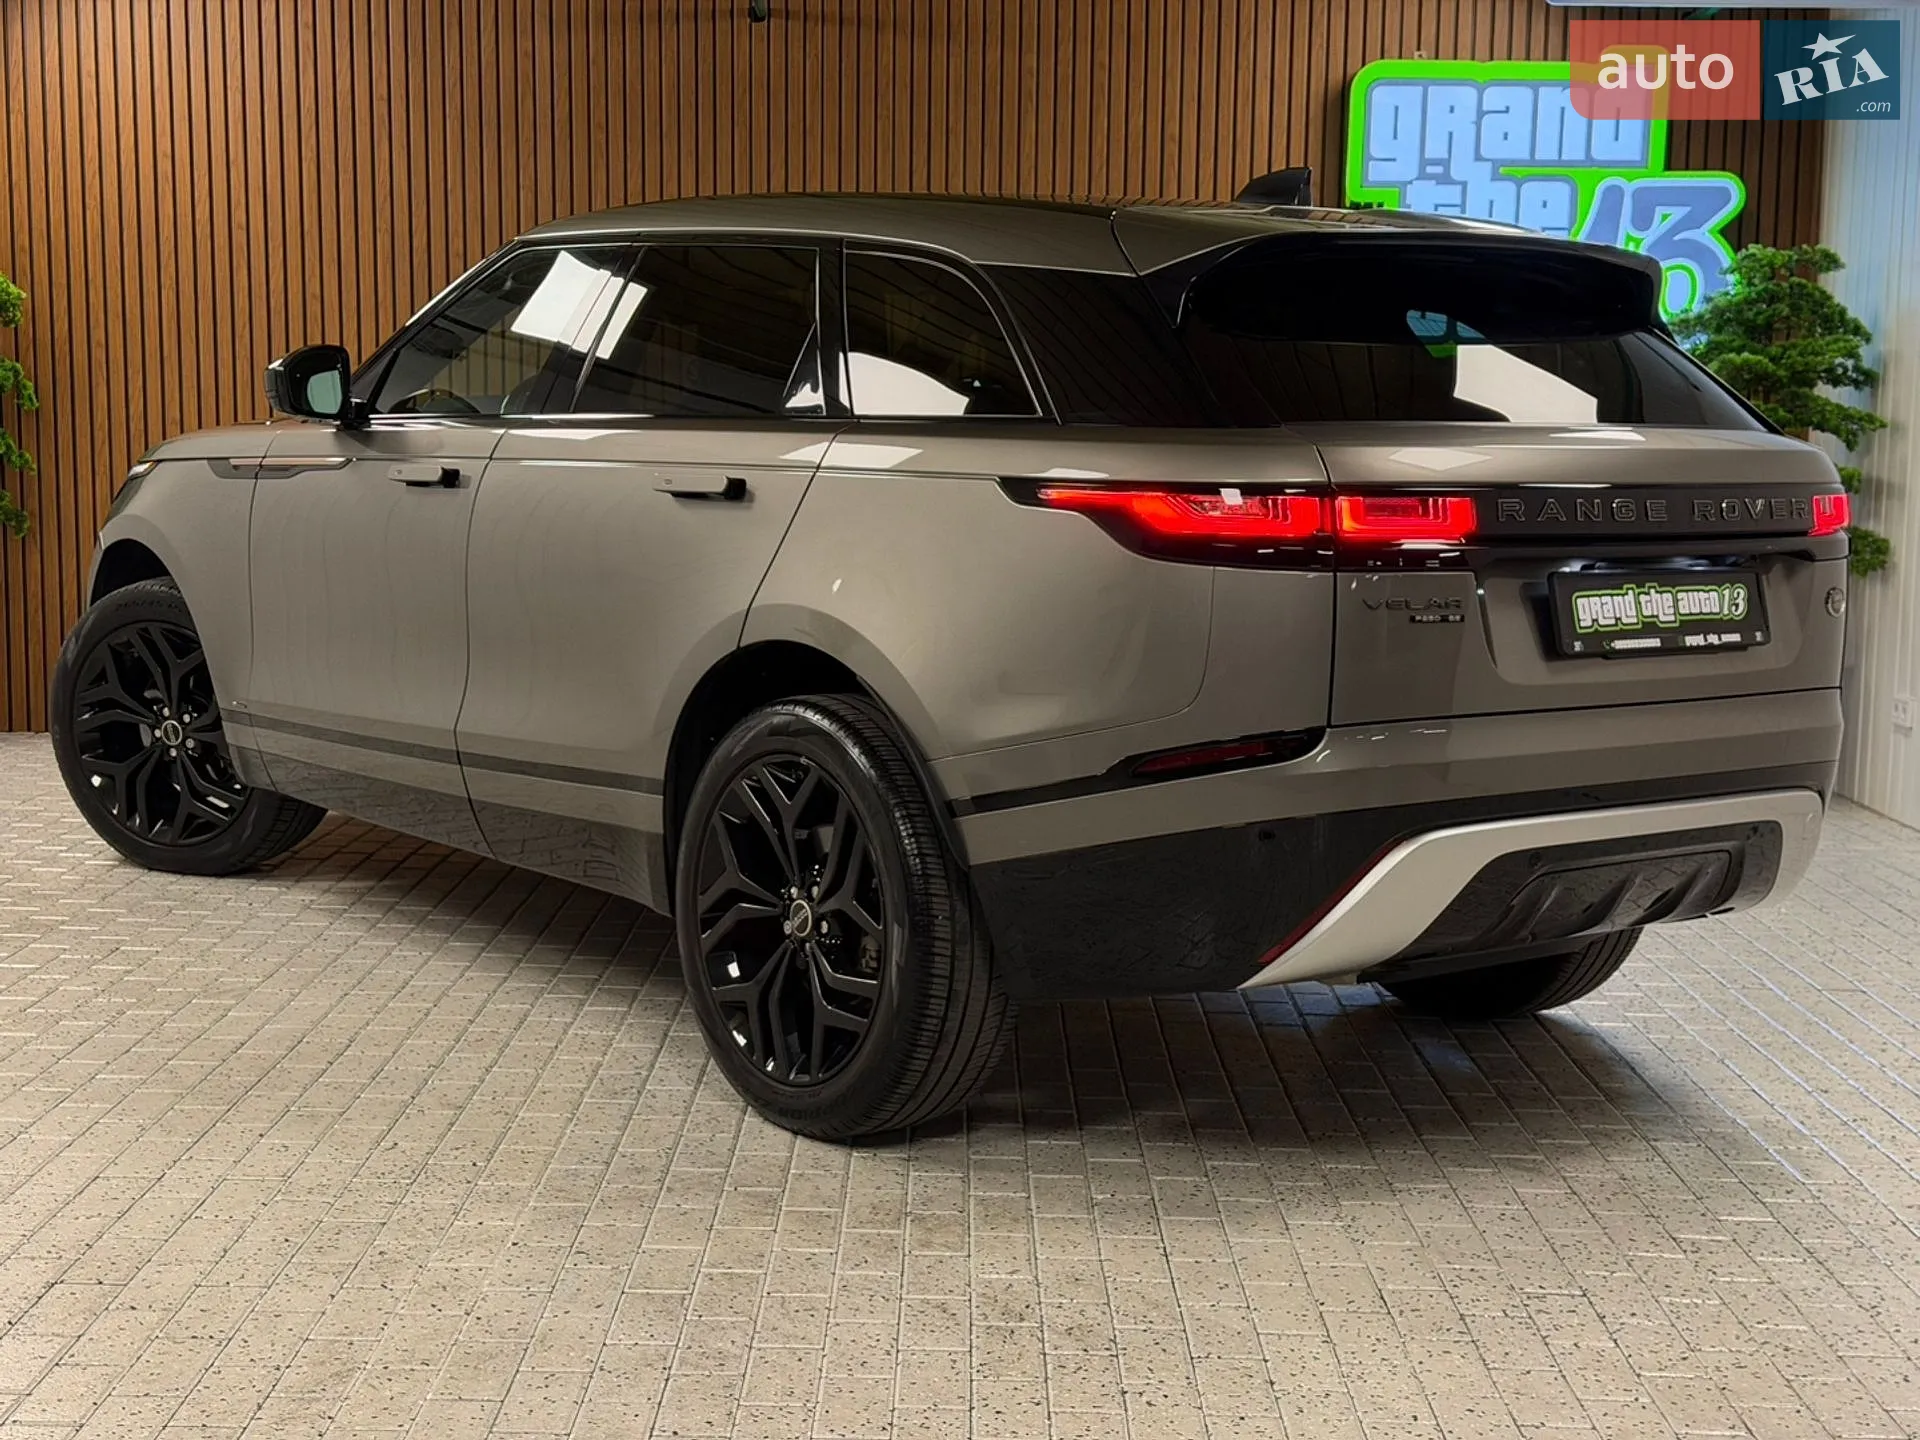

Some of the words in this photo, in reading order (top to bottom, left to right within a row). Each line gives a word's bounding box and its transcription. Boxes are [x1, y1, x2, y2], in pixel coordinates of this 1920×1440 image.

[1497, 498, 1669, 522] RANGE
[1693, 497, 1810, 522] ROVER
[1361, 597, 1464, 611] VELAR
[1576, 589, 1638, 627] grand
[1639, 588, 1676, 622] the
